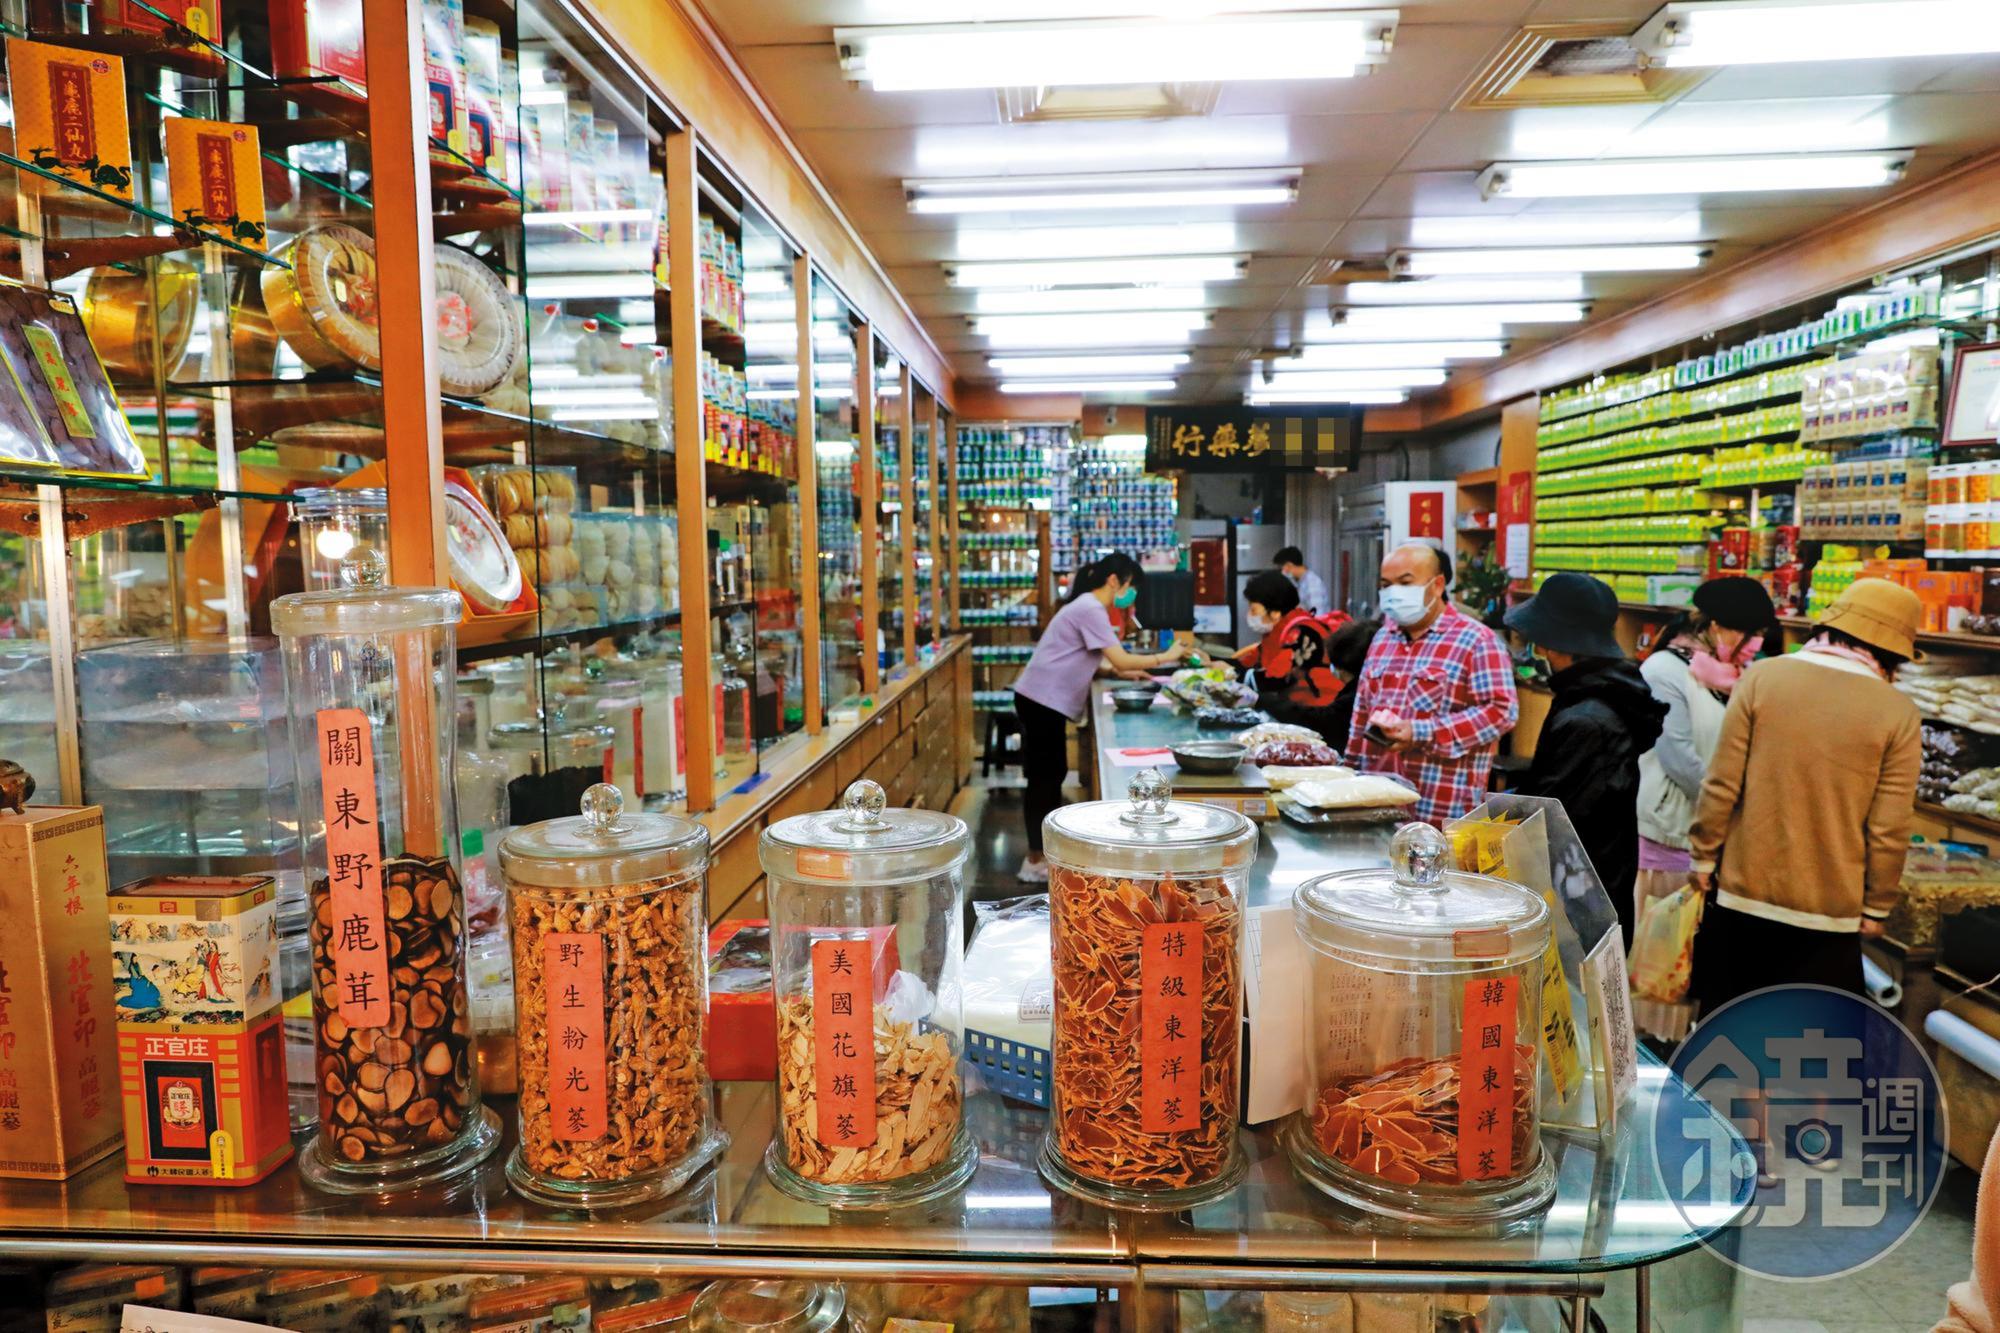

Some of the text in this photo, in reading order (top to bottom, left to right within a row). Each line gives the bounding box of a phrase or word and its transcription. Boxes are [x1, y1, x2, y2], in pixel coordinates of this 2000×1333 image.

[61, 80, 88, 161] 龜鹿二仙丸
[62, 854, 84, 916] 六年根
[325, 725, 379, 1011] 關東野鹿茸
[144, 1036, 209, 1057] 正官庄
[559, 943, 590, 1134] 野生粉光蔘
[829, 948, 858, 1141] 美國花旗蔘
[1160, 930, 1188, 1126] 特級東洋蔘
[1476, 979, 1506, 1178] 韓國東洋蔘
